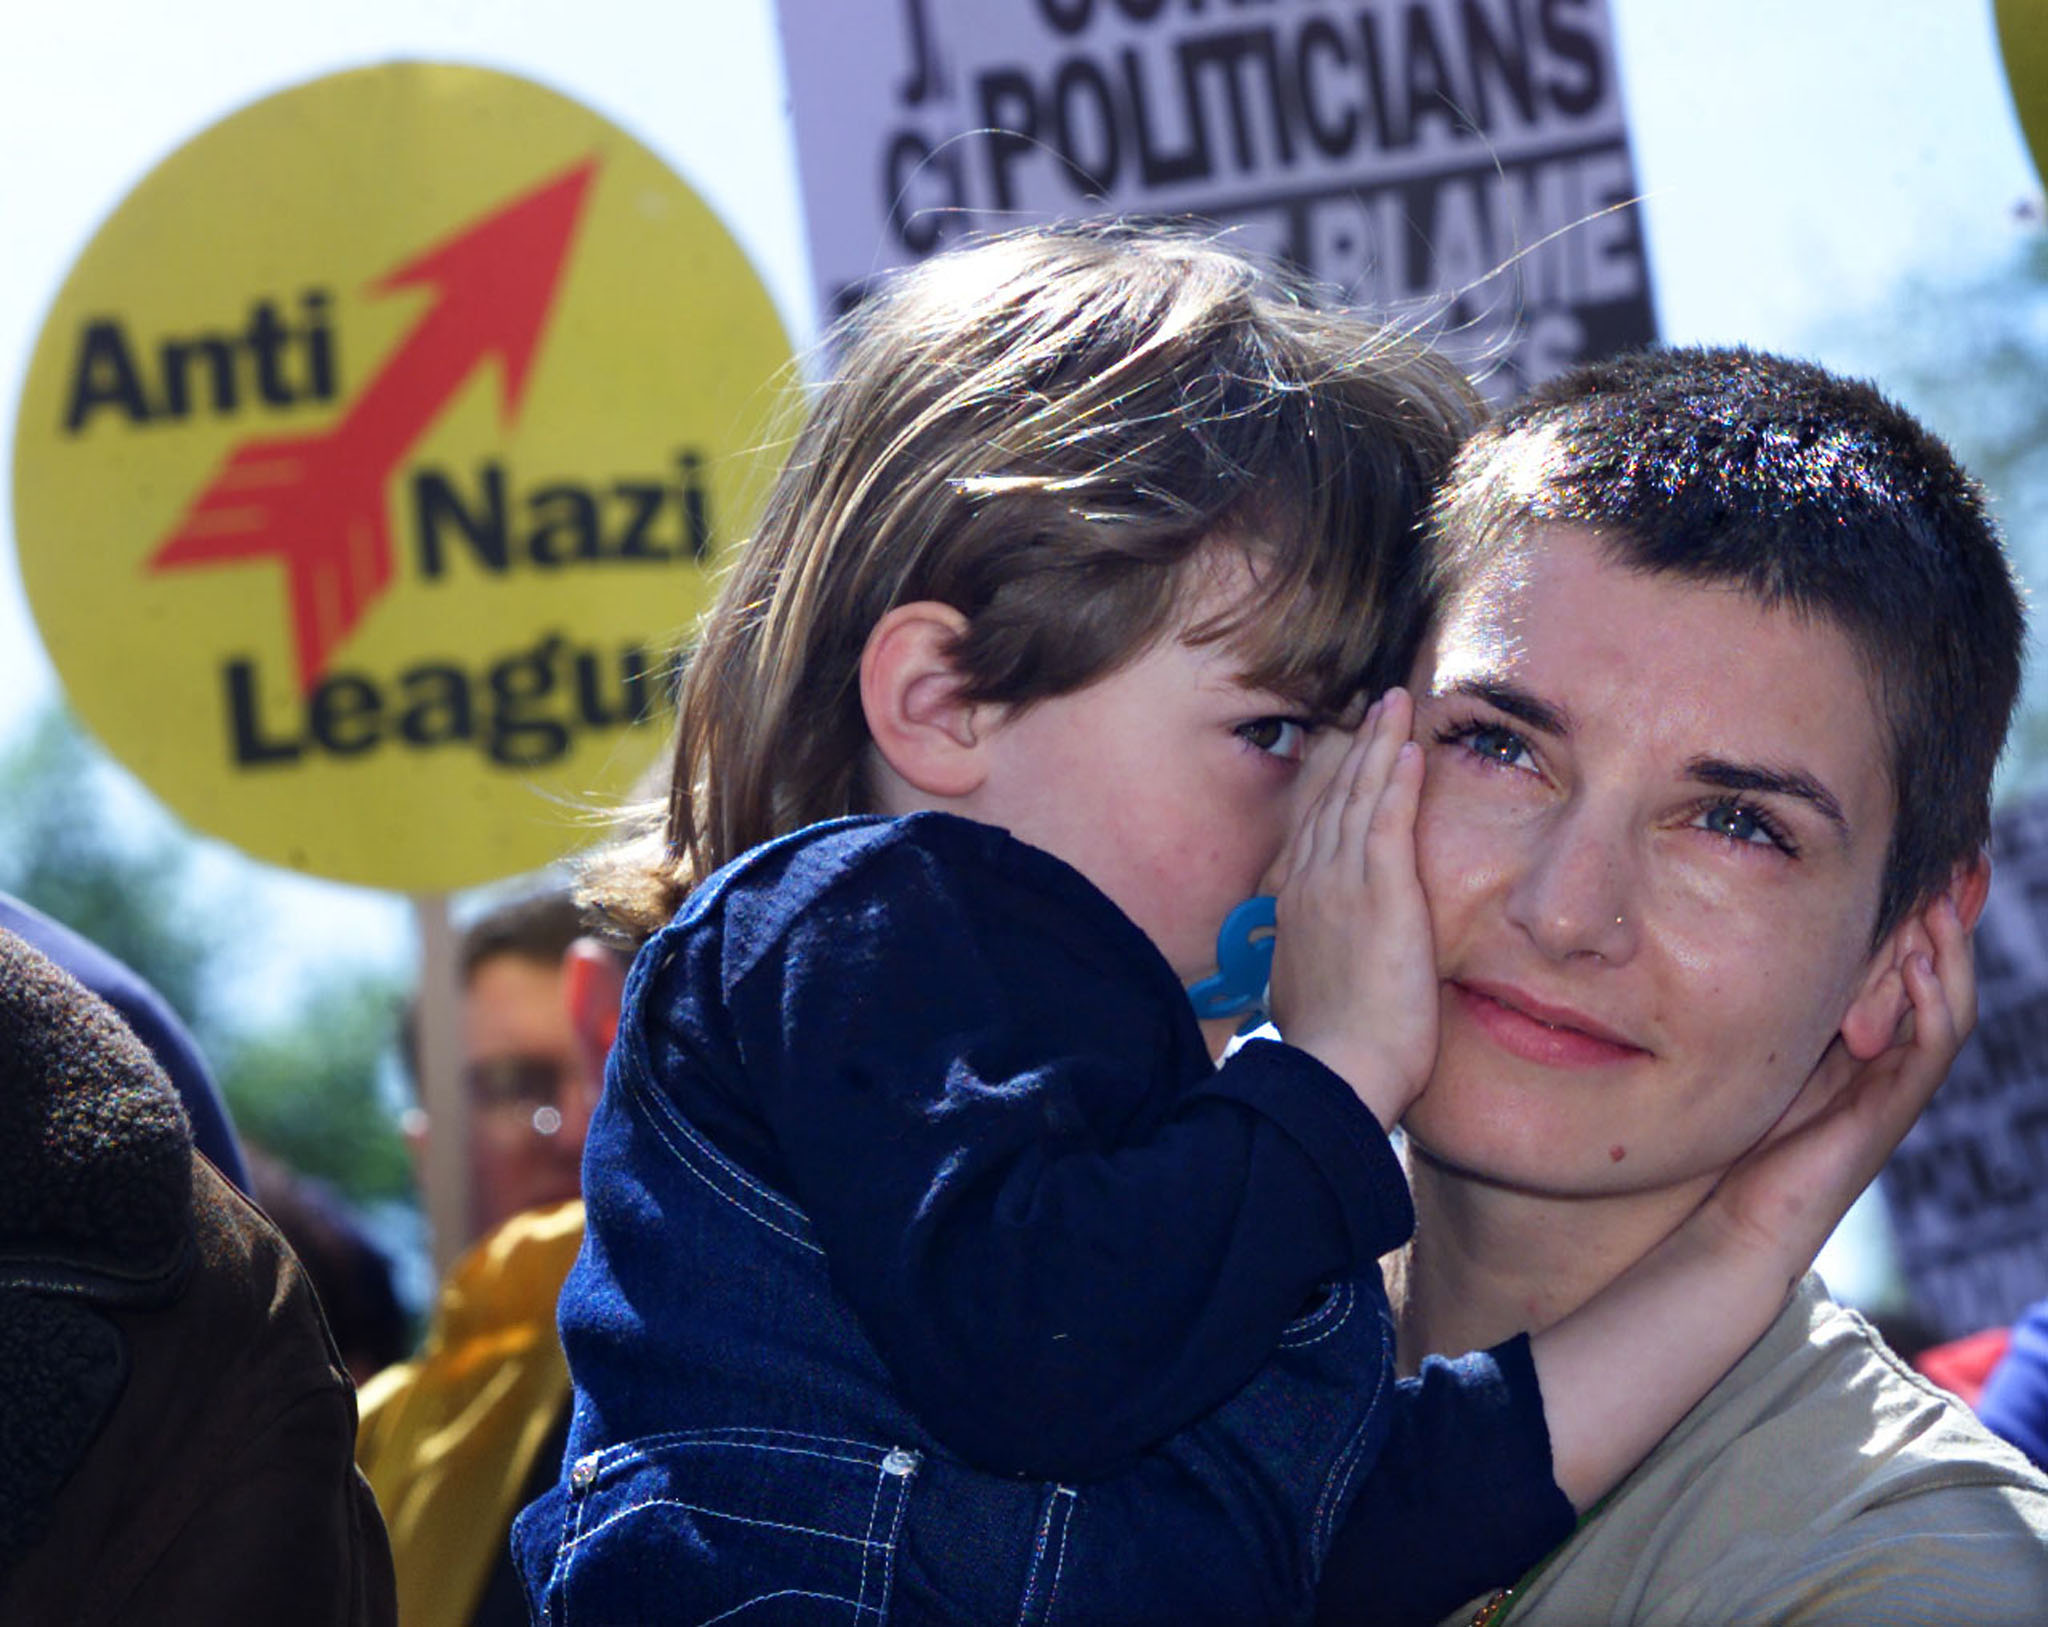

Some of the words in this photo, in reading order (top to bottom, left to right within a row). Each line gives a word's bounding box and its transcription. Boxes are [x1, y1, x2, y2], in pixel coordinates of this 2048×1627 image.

[977, 0, 1604, 212] POLITICIANS
[64, 291, 338, 435] Anti
[411, 451, 711, 581] Nazi
[221, 634, 690, 768] Leagu
